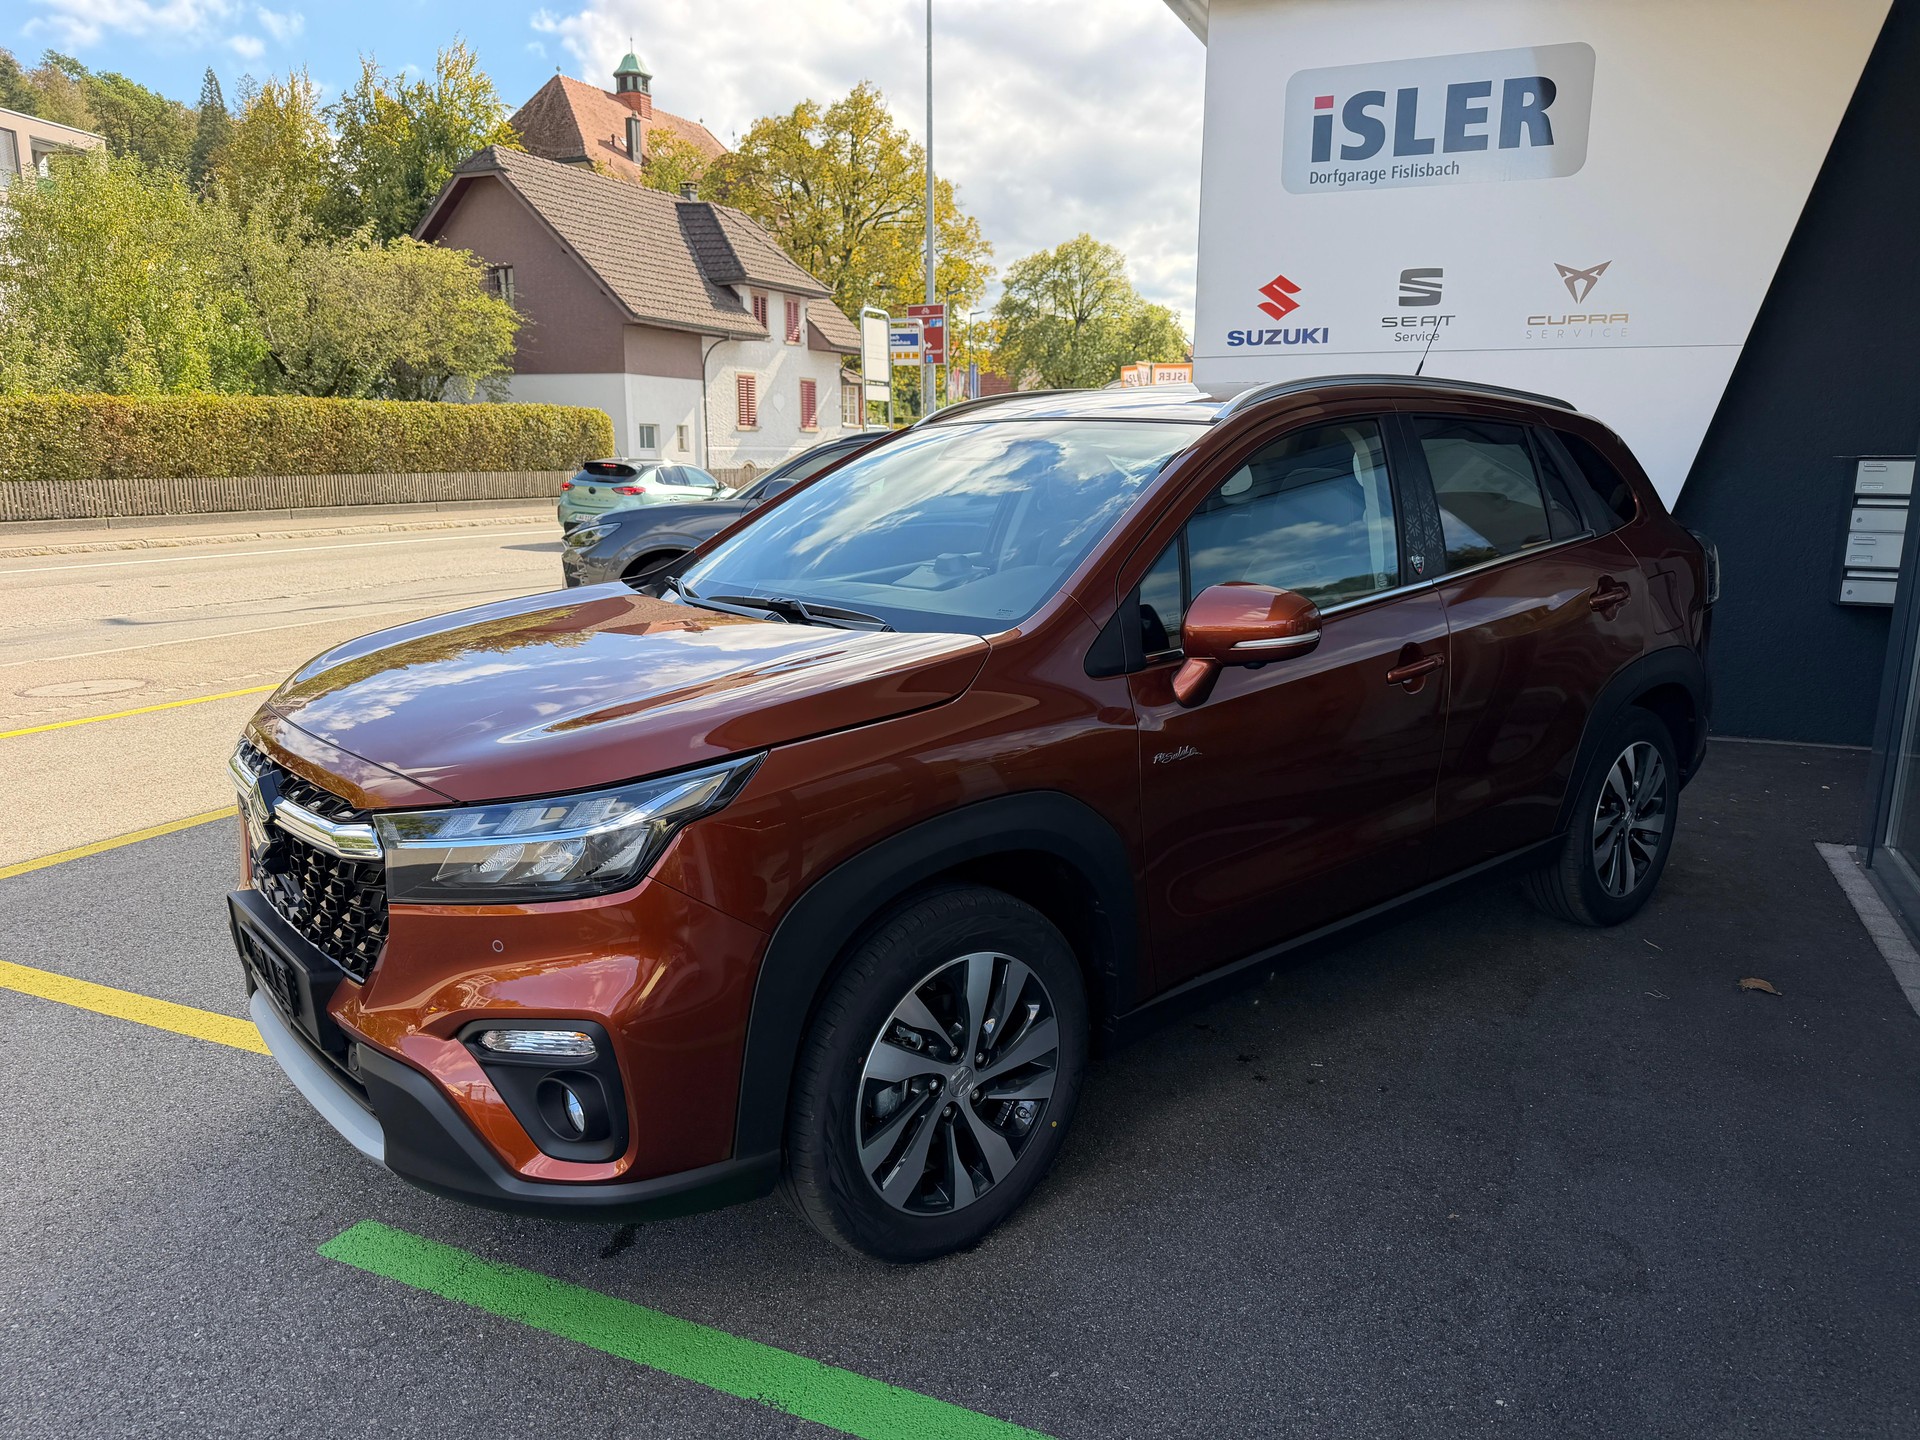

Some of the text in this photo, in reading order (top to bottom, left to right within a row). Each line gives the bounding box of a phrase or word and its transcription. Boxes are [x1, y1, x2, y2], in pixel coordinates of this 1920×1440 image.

[1311, 76, 1557, 163] iSLER
[1309, 160, 1460, 186] Dorfgarage Fislisbach
[1381, 315, 1456, 328] SEAT
[1527, 313, 1629, 326] CUPRA
[1226, 327, 1329, 347] SUZUKI
[1394, 331, 1440, 342] Service
[1526, 328, 1628, 340] SERVICE
